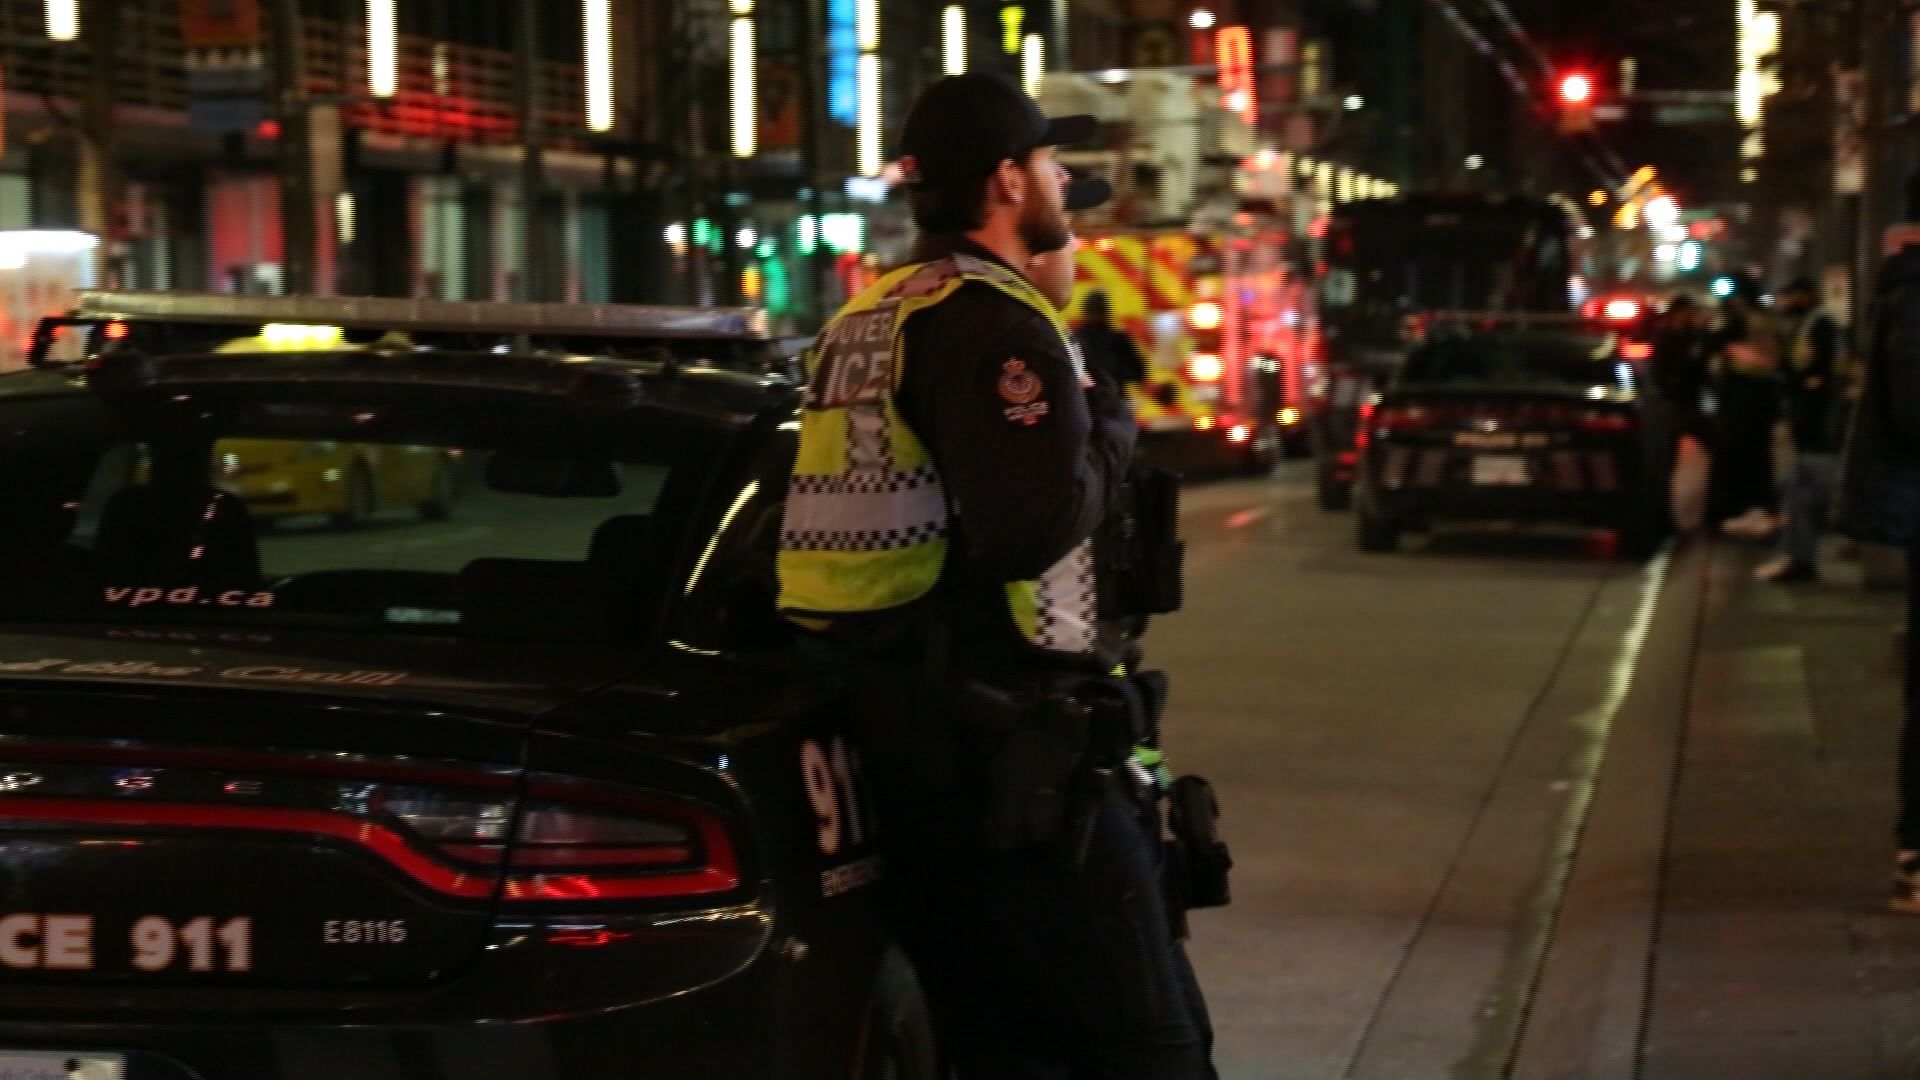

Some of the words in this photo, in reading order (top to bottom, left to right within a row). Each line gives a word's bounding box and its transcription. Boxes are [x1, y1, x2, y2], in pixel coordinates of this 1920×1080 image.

[104, 585, 275, 608] vpd.ca
[0, 913, 95, 971] CE
[130, 914, 254, 972] 911
[322, 919, 408, 944] E8116
